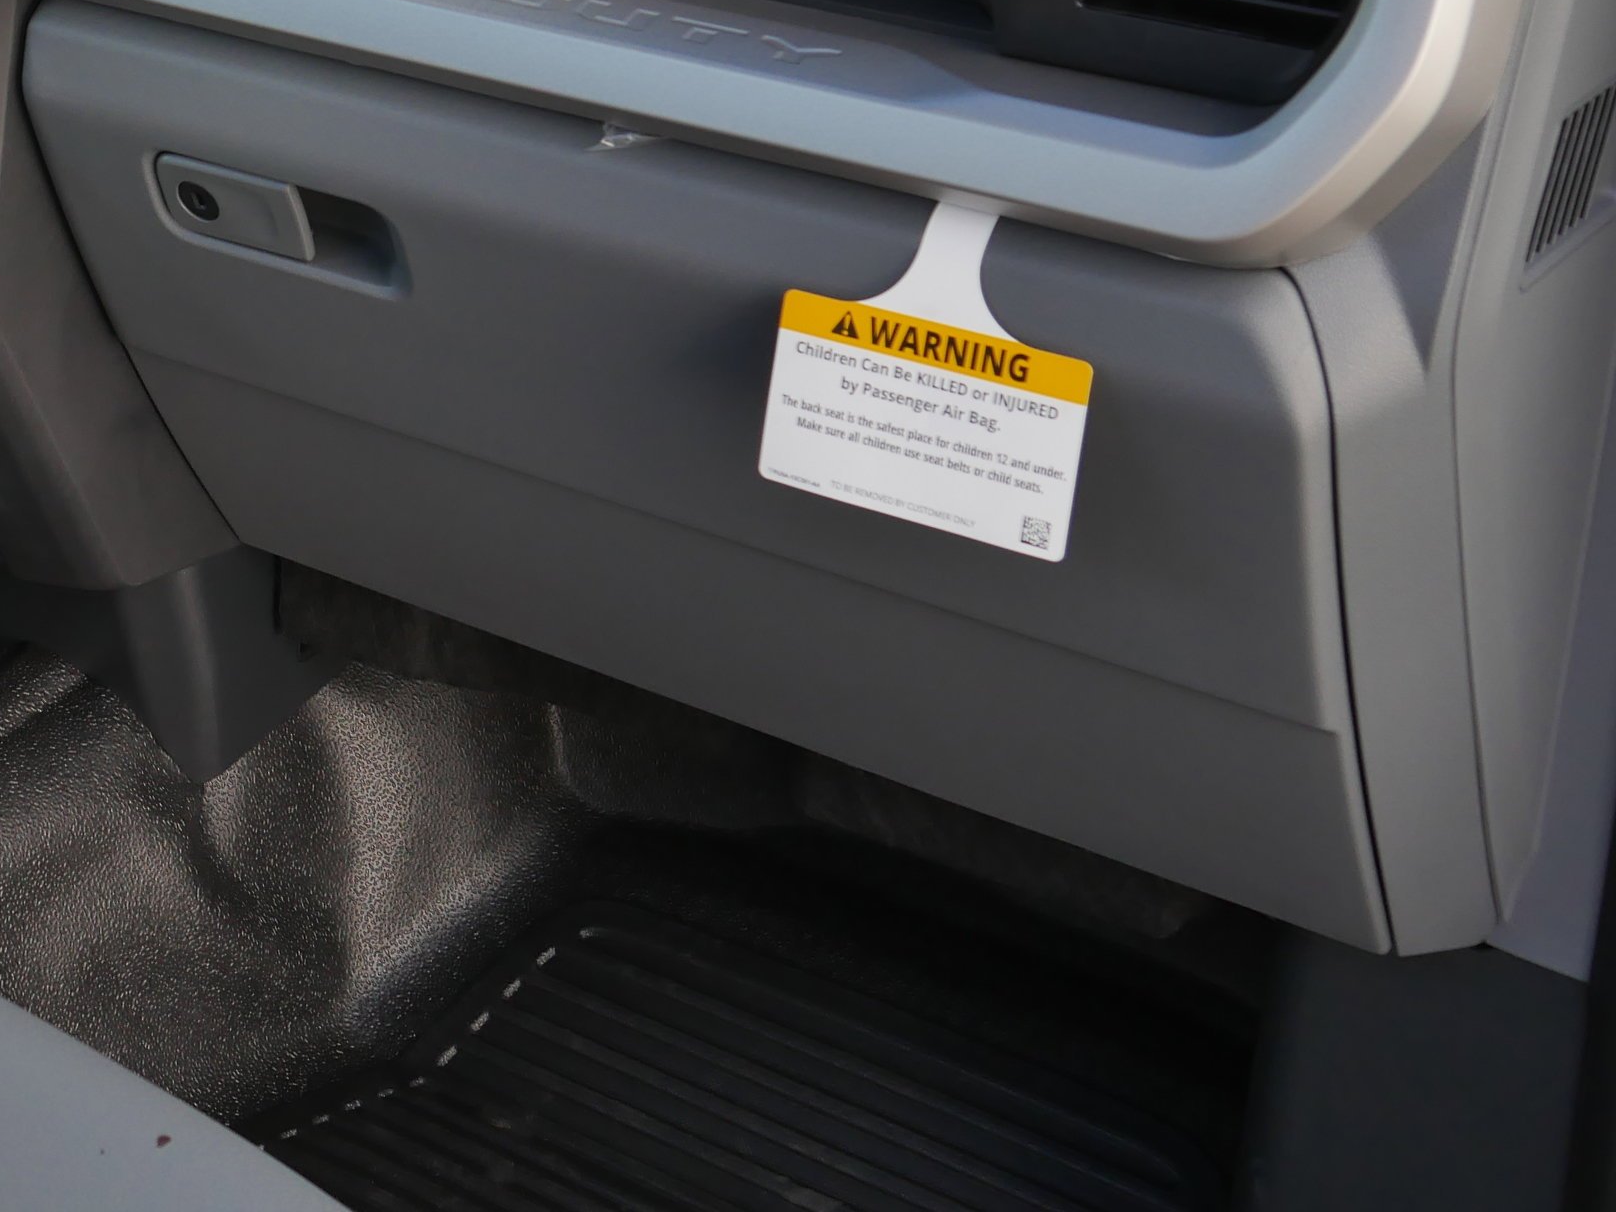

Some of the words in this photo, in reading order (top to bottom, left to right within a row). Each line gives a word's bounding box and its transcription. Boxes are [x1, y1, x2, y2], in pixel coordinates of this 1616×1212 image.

[796, 341, 857, 368] Children
[862, 358, 889, 376] Can
[894, 366, 912, 382] Be
[917, 372, 968, 396] KILLED
[972, 389, 989, 401] or
[993, 392, 1059, 420] INJURED
[871, 316, 1031, 383] WARNING
[782, 394, 799, 409] The
[801, 400, 823, 415] back
[825, 408, 846, 421] seat
[847, 412, 855, 423] is
[858, 416, 874, 429] the
[877, 422, 905, 438] safest
[907, 430, 933, 446] place
[936, 436, 950, 449] for
[953, 441, 993, 461] children
[997, 453, 1008, 466] 12
[1011, 457, 1031, 471] and
[1033, 464, 1067, 482] under.
[841, 375, 859, 395] by
[863, 382, 938, 413] Passenger
[942, 404, 965, 421] Air
[969, 410, 1001, 434] Bag.
[797, 416, 823, 434] Make
[825, 426, 845, 440] sure
[848, 432, 860, 444] all
[862, 435, 902, 455] children
[904, 448, 921, 460] use
[923, 452, 945, 467] seat
[947, 459, 971, 474] belts
[974, 467, 984, 477] or
[987, 470, 1012, 486] child
[1014, 477, 1044, 495] seats.
[831, 480, 843, 490] TO
[843, 483, 854, 495] BE
[855, 486, 894, 505] REMOVED
[895, 497, 905, 508] BY
[907, 500, 953, 522] CUSTOMER
[953, 514, 977, 529] ONLY
